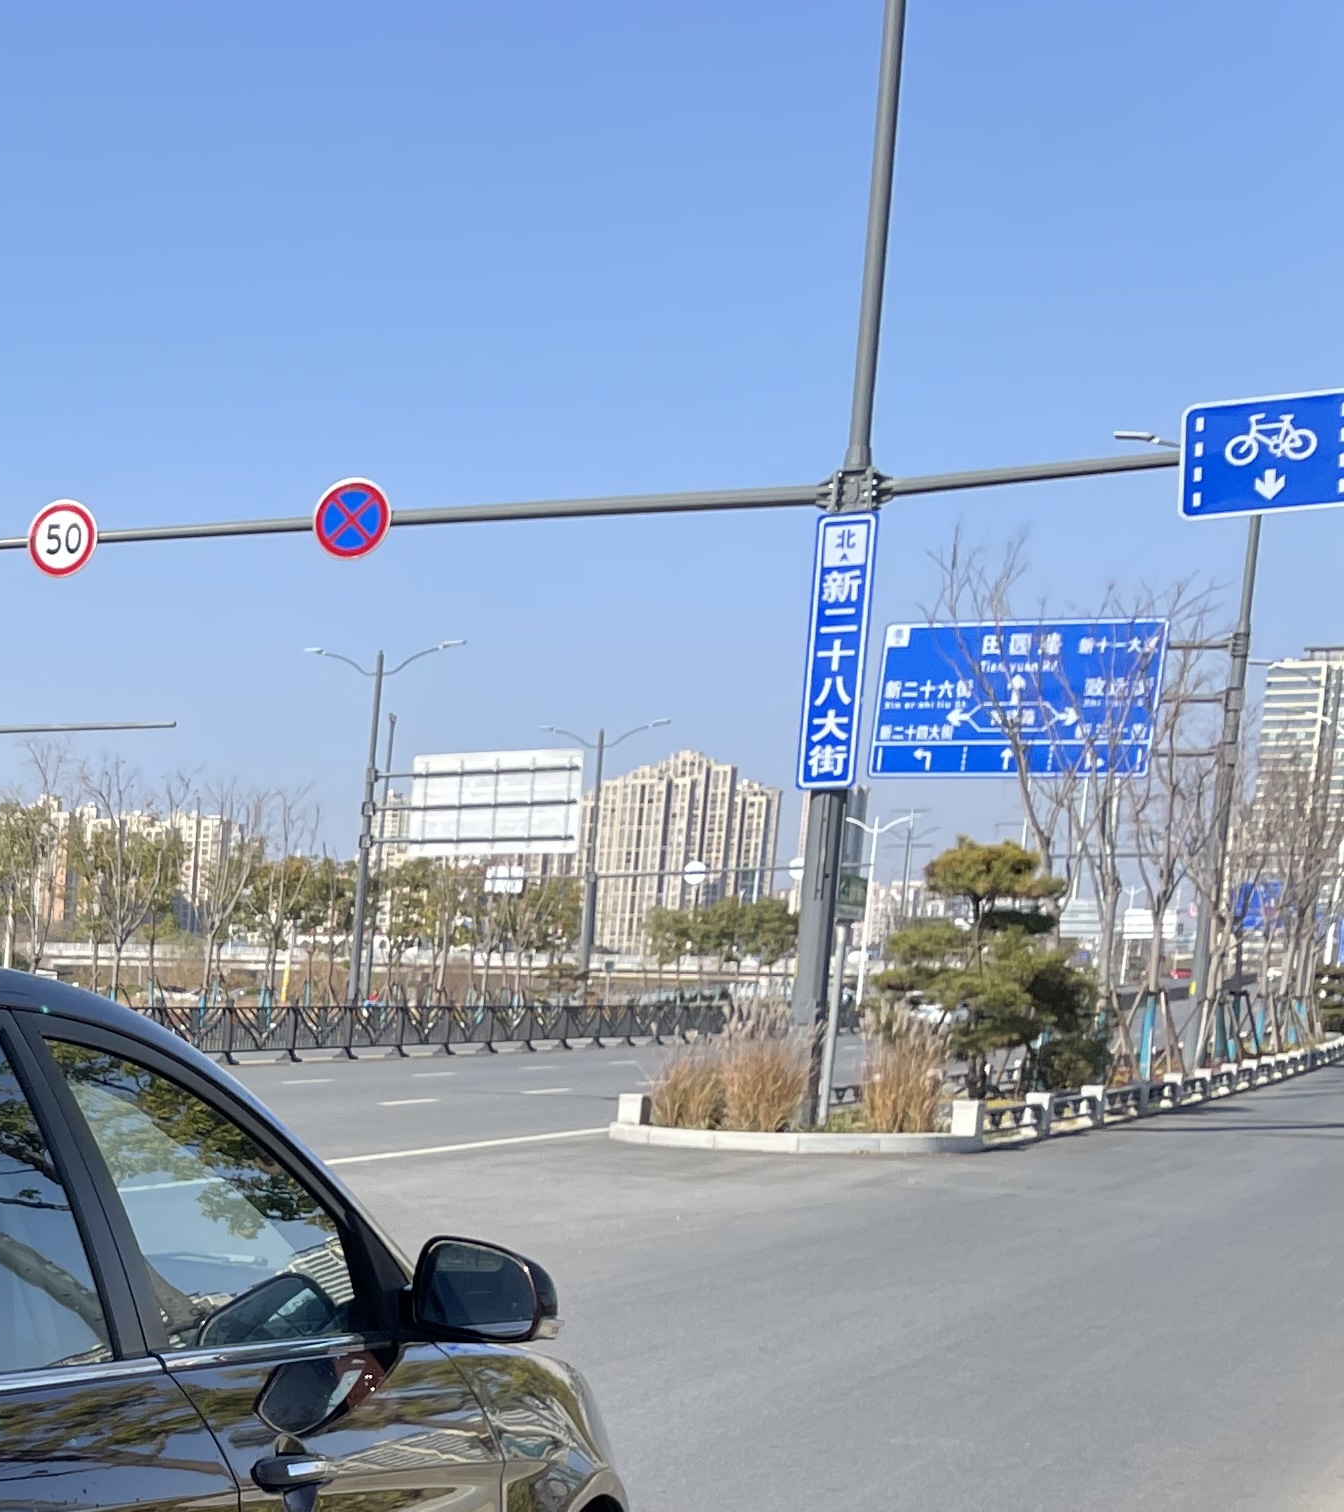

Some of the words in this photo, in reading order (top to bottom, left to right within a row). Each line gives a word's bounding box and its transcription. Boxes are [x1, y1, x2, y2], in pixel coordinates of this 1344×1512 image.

[45, 522, 82, 555] 50
[835, 529, 857, 550] 北
[808, 569, 863, 778] 新二十八大街
